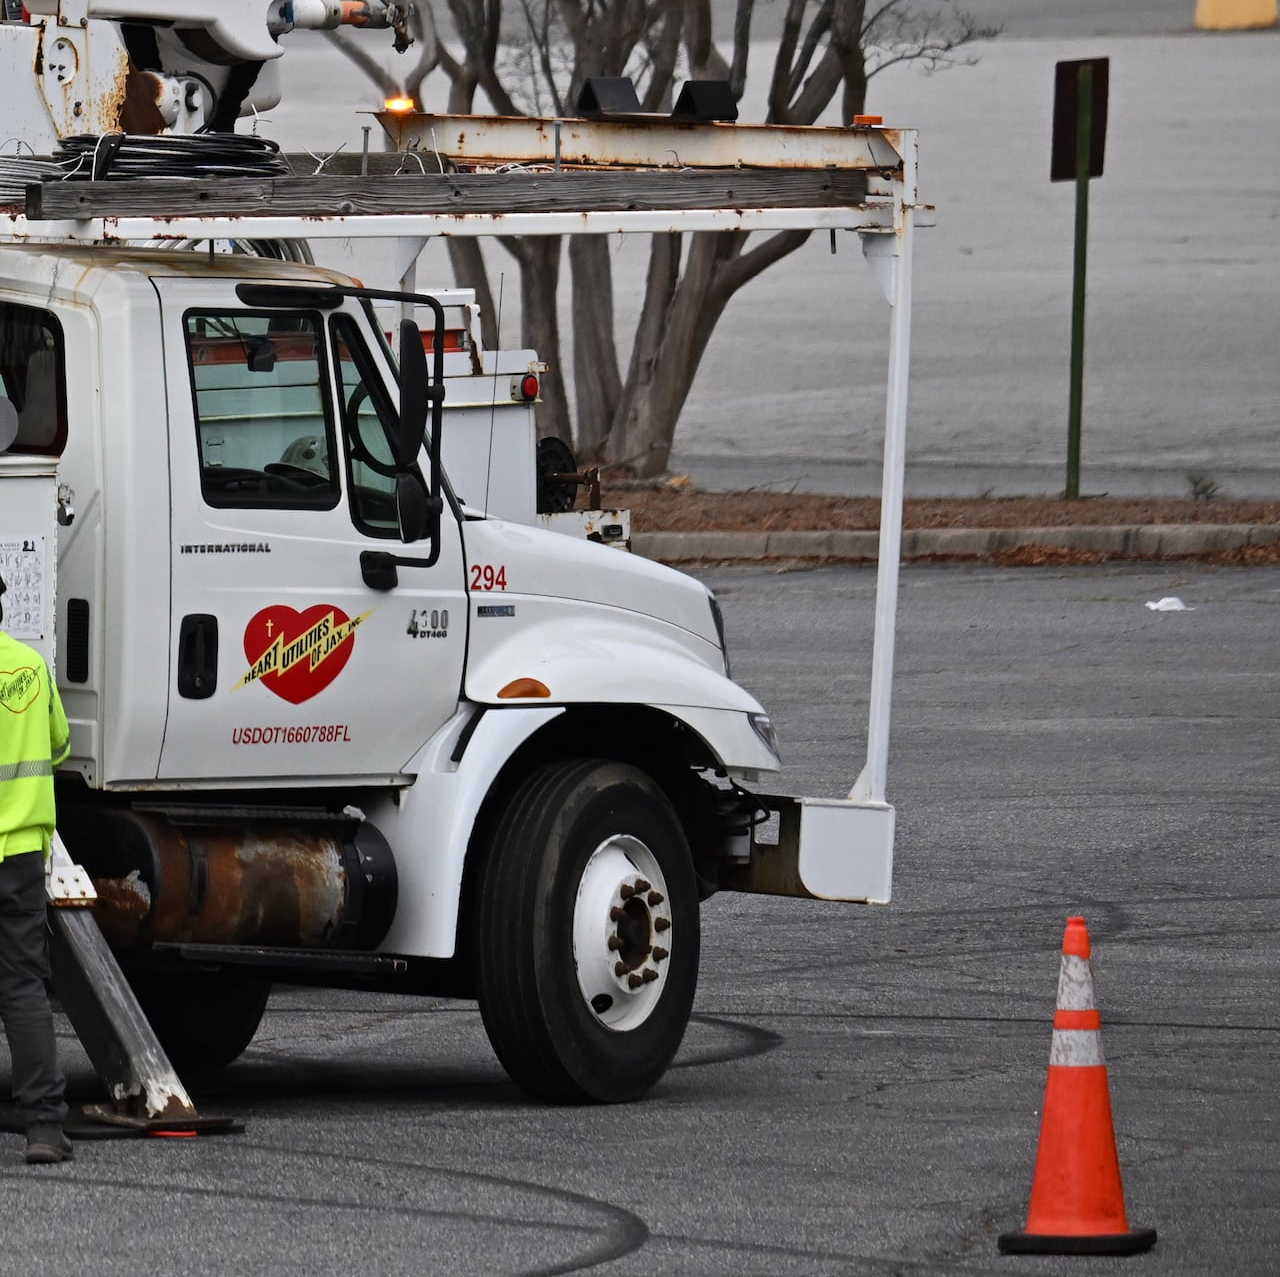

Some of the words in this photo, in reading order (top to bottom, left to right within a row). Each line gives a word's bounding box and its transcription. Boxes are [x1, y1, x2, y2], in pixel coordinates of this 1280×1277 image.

[180, 543, 271, 554] INTERNATIONAL
[471, 565, 507, 591] 294
[420, 630, 448, 638] DT466
[244, 642, 280, 684] HEART
[282, 618, 330, 669] UTILITIES
[311, 645, 322, 667] OF
[232, 725, 352, 745] USDOT1660788FL
